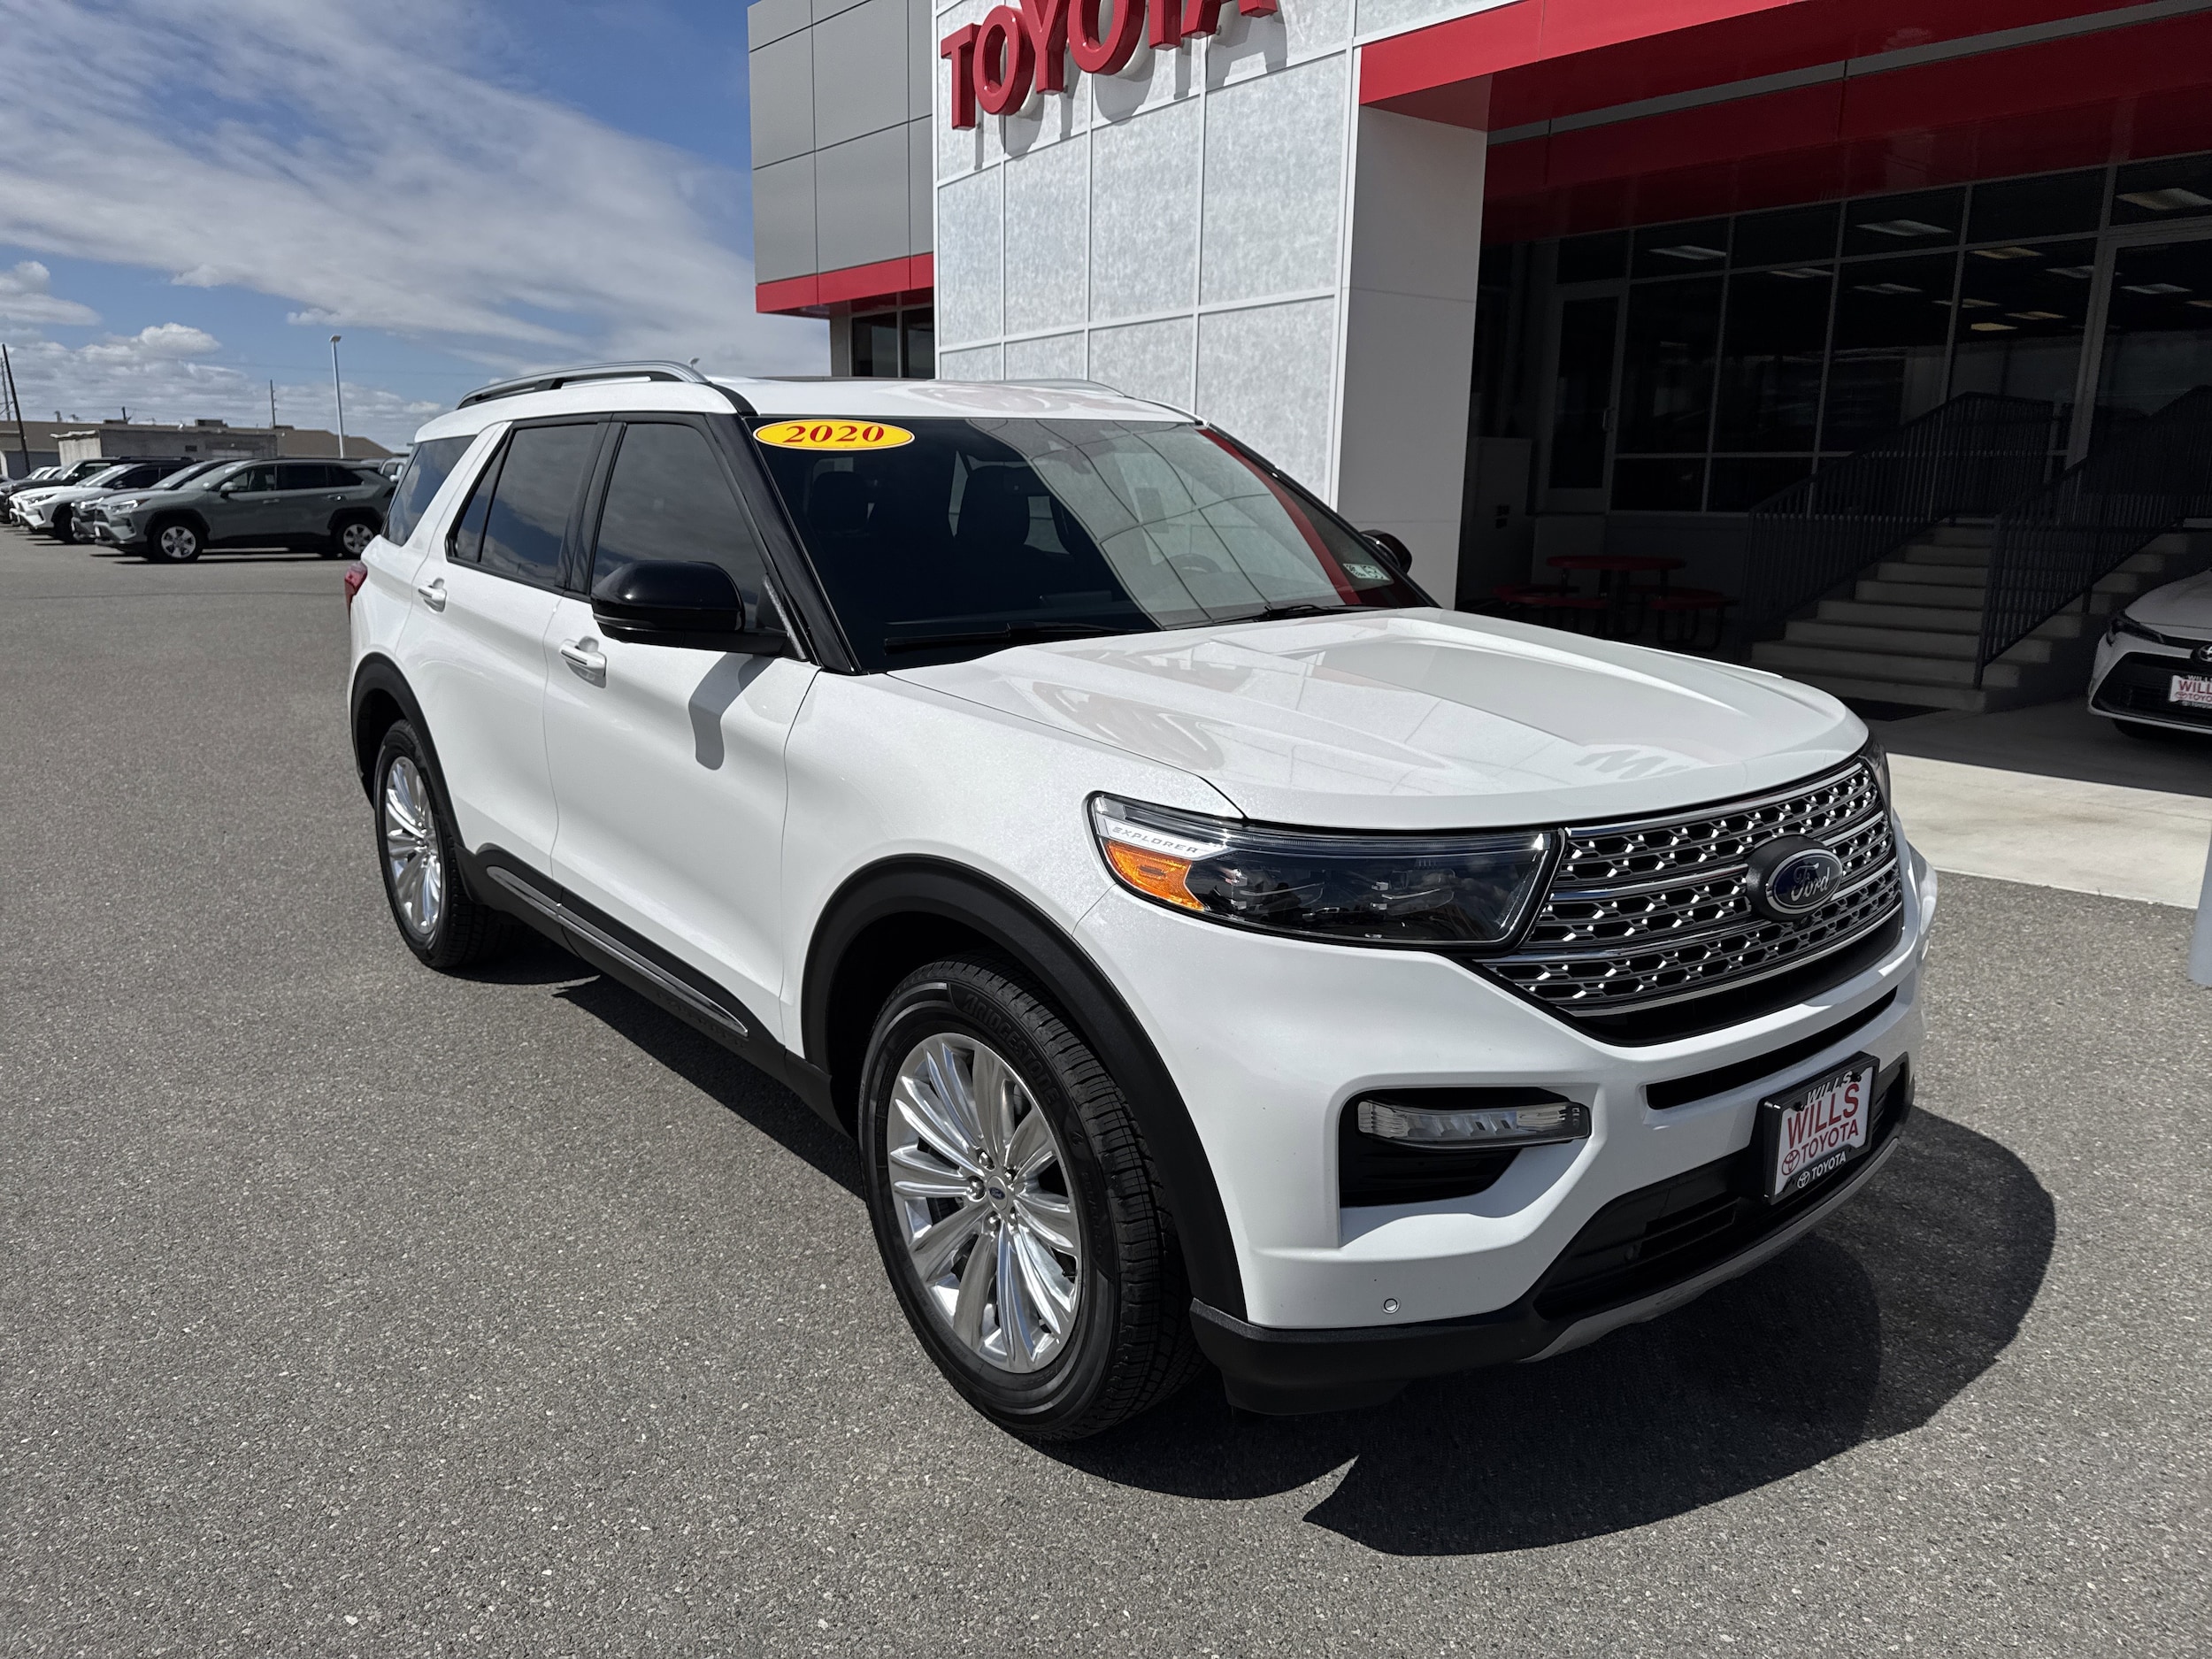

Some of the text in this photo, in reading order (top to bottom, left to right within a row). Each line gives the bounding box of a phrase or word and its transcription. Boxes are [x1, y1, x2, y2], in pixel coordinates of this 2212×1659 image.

[941, 0, 1279, 131] TOYO
[782, 425, 885, 443] 2020
[1112, 826, 1198, 853] EXPLORER
[1791, 863, 1831, 901] Ford
[963, 993, 1060, 1104] BRIDGESTONE
[1807, 1071, 1853, 1104] WILLS
[1787, 1083, 1860, 1148] WILLS
[1801, 1119, 1859, 1163] TOYOTA
[1811, 1151, 1846, 1179] TOYOTA
